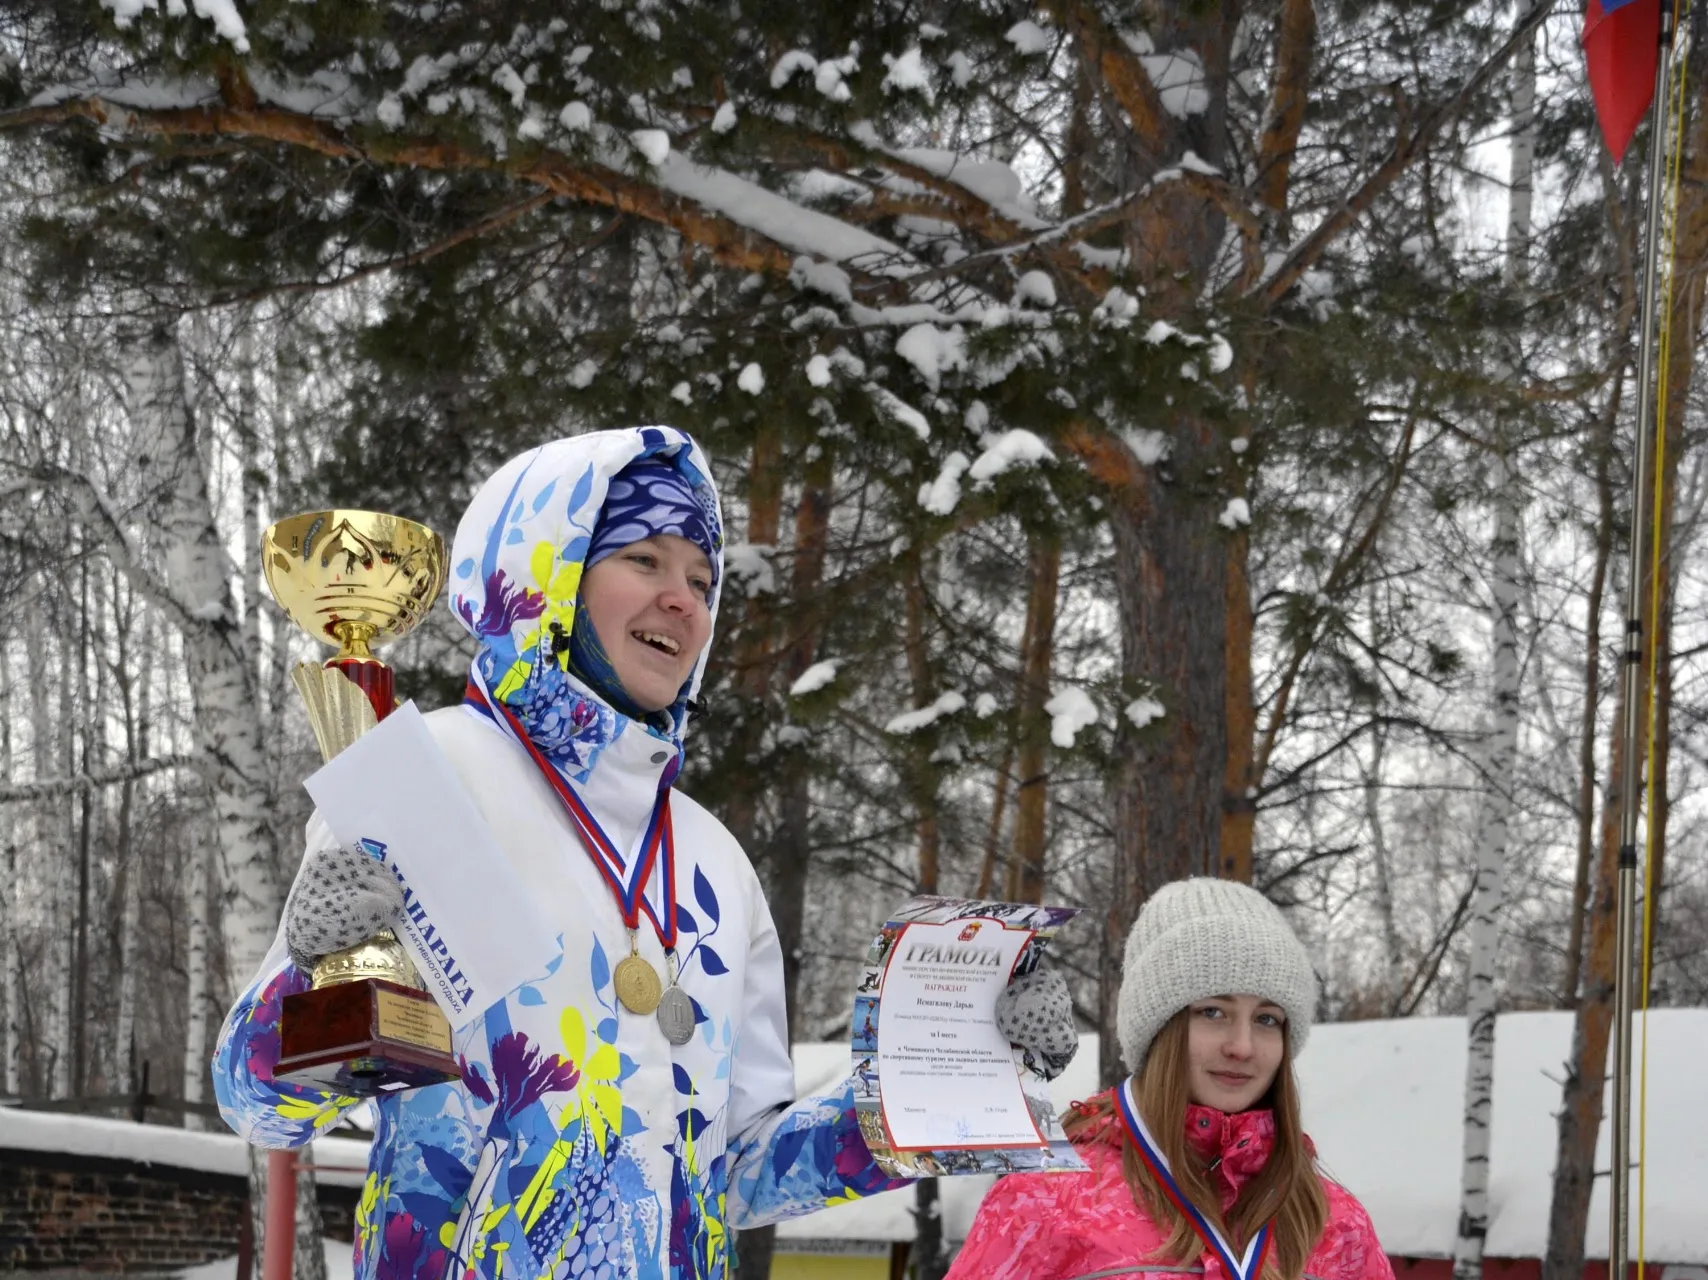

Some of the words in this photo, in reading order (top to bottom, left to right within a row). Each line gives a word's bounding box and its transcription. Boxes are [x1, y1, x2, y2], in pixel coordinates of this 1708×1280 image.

[905, 942, 1004, 967] ГРАМОТА
[410, 932, 441, 981] АКТИВНОГО
[440, 980, 463, 1015] ОТДЫХА
[924, 983, 968, 992] НАГРАЖДАЕТ
[954, 1000, 974, 1010] Дарью
